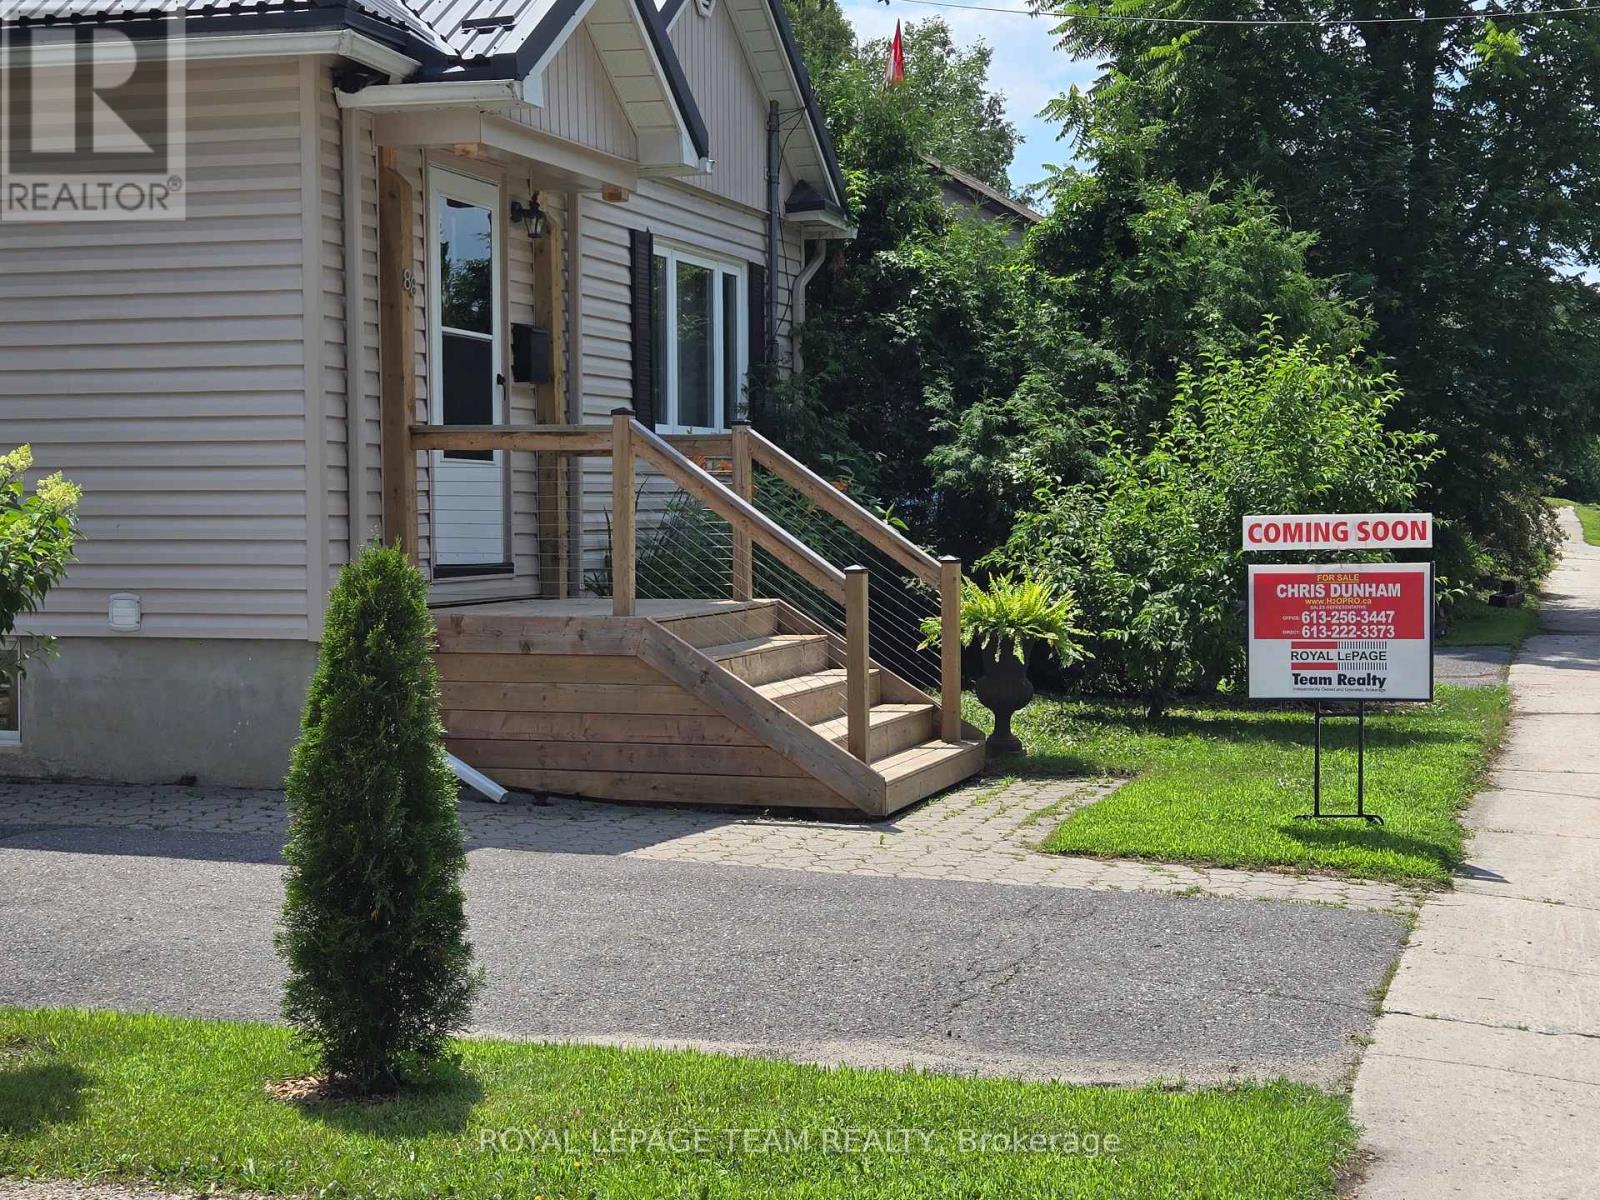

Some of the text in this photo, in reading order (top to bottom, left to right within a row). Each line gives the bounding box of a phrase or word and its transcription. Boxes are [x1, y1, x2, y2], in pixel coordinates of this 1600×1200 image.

[1248, 520, 1427, 544] COMING SOON
[1316, 574, 1360, 582] FOR SALE
[1276, 583, 1401, 598] CHRIS DUNHAM
[1305, 597, 1372, 605] www.H2OPRO.ca
[1301, 610, 1395, 624] 613-256-3447
[1301, 625, 1395, 639] 613-222-3373
[1290, 651, 1334, 661] ROYAL
[1292, 672, 1387, 688] Team Realty
